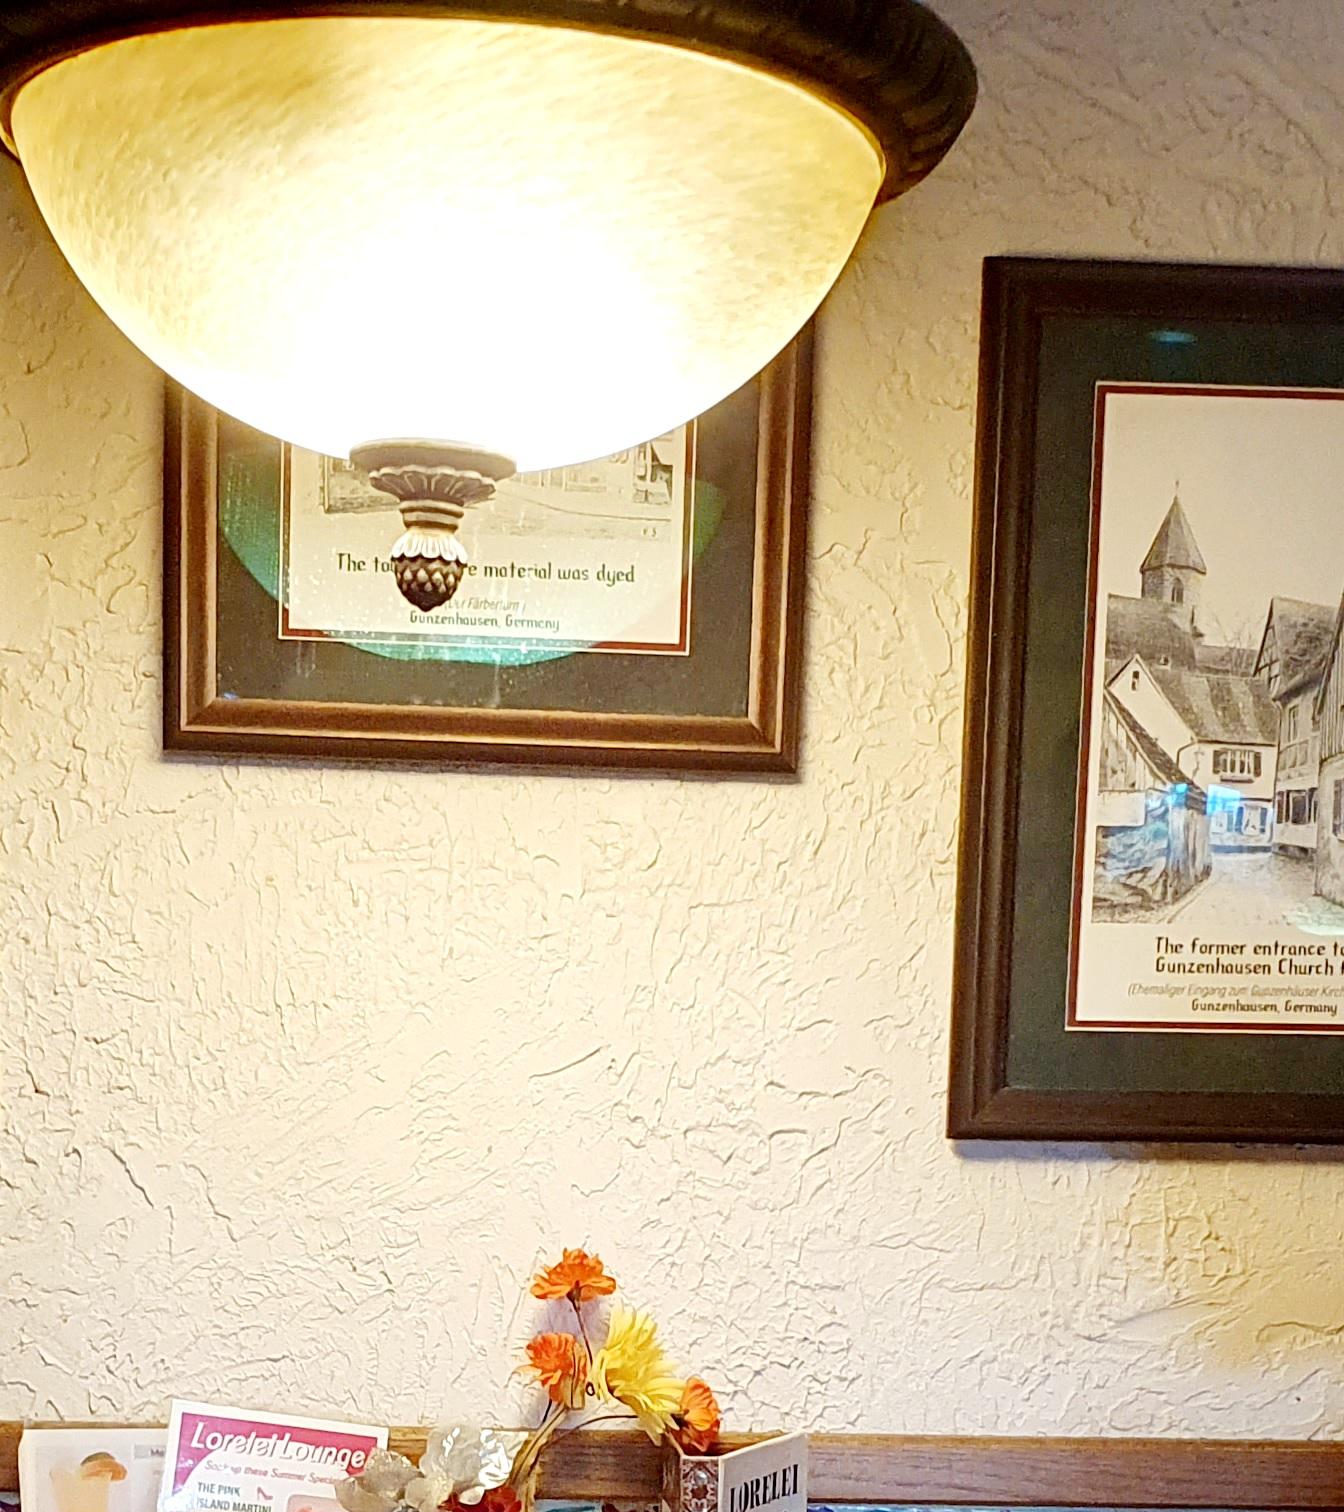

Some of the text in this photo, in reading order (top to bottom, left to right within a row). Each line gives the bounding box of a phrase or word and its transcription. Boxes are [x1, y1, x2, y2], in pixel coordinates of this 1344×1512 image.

[336, 552, 367, 572] The
[483, 562, 553, 581] material
[557, 568, 590, 582] was
[596, 563, 636, 588] dyed
[505, 614, 561, 633] Germany
[1155, 936, 1184, 954] The
[1191, 937, 1246, 955] former
[1253, 940, 1326, 957] entrance
[1155, 956, 1271, 976] Gunzenhausen
[1278, 958, 1334, 977] Church
[1284, 999, 1338, 1017] Germany
[190, 1421, 366, 1472] Lorelei Lounge
[197, 1481, 241, 1497] THE PINK
